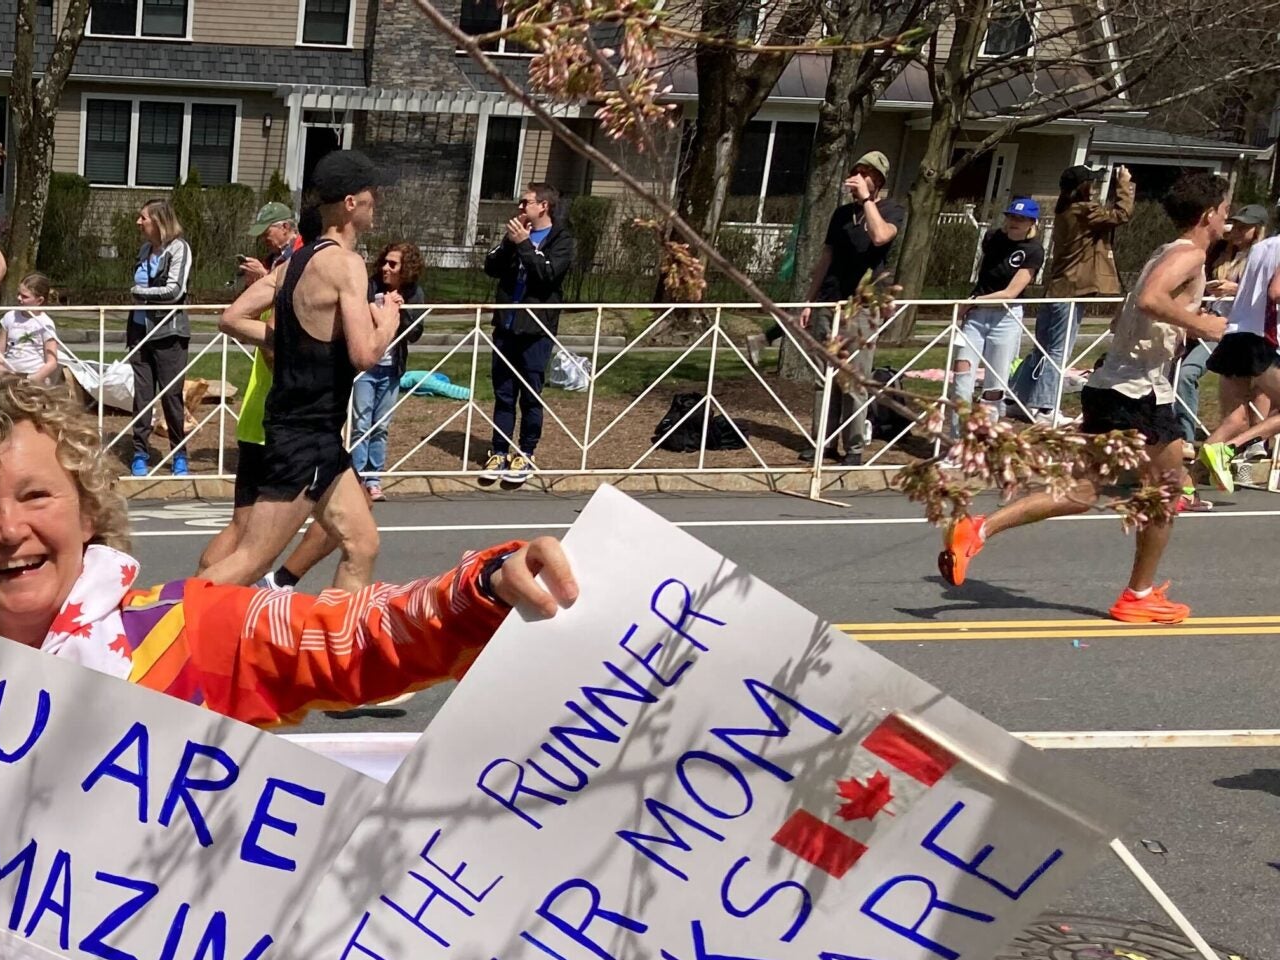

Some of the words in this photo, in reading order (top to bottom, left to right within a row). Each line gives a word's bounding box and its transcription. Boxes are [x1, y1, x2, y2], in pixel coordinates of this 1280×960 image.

[81, 721, 326, 872] ARE
[476, 577, 727, 831] RUNNER
[615, 676, 843, 882] MOM
